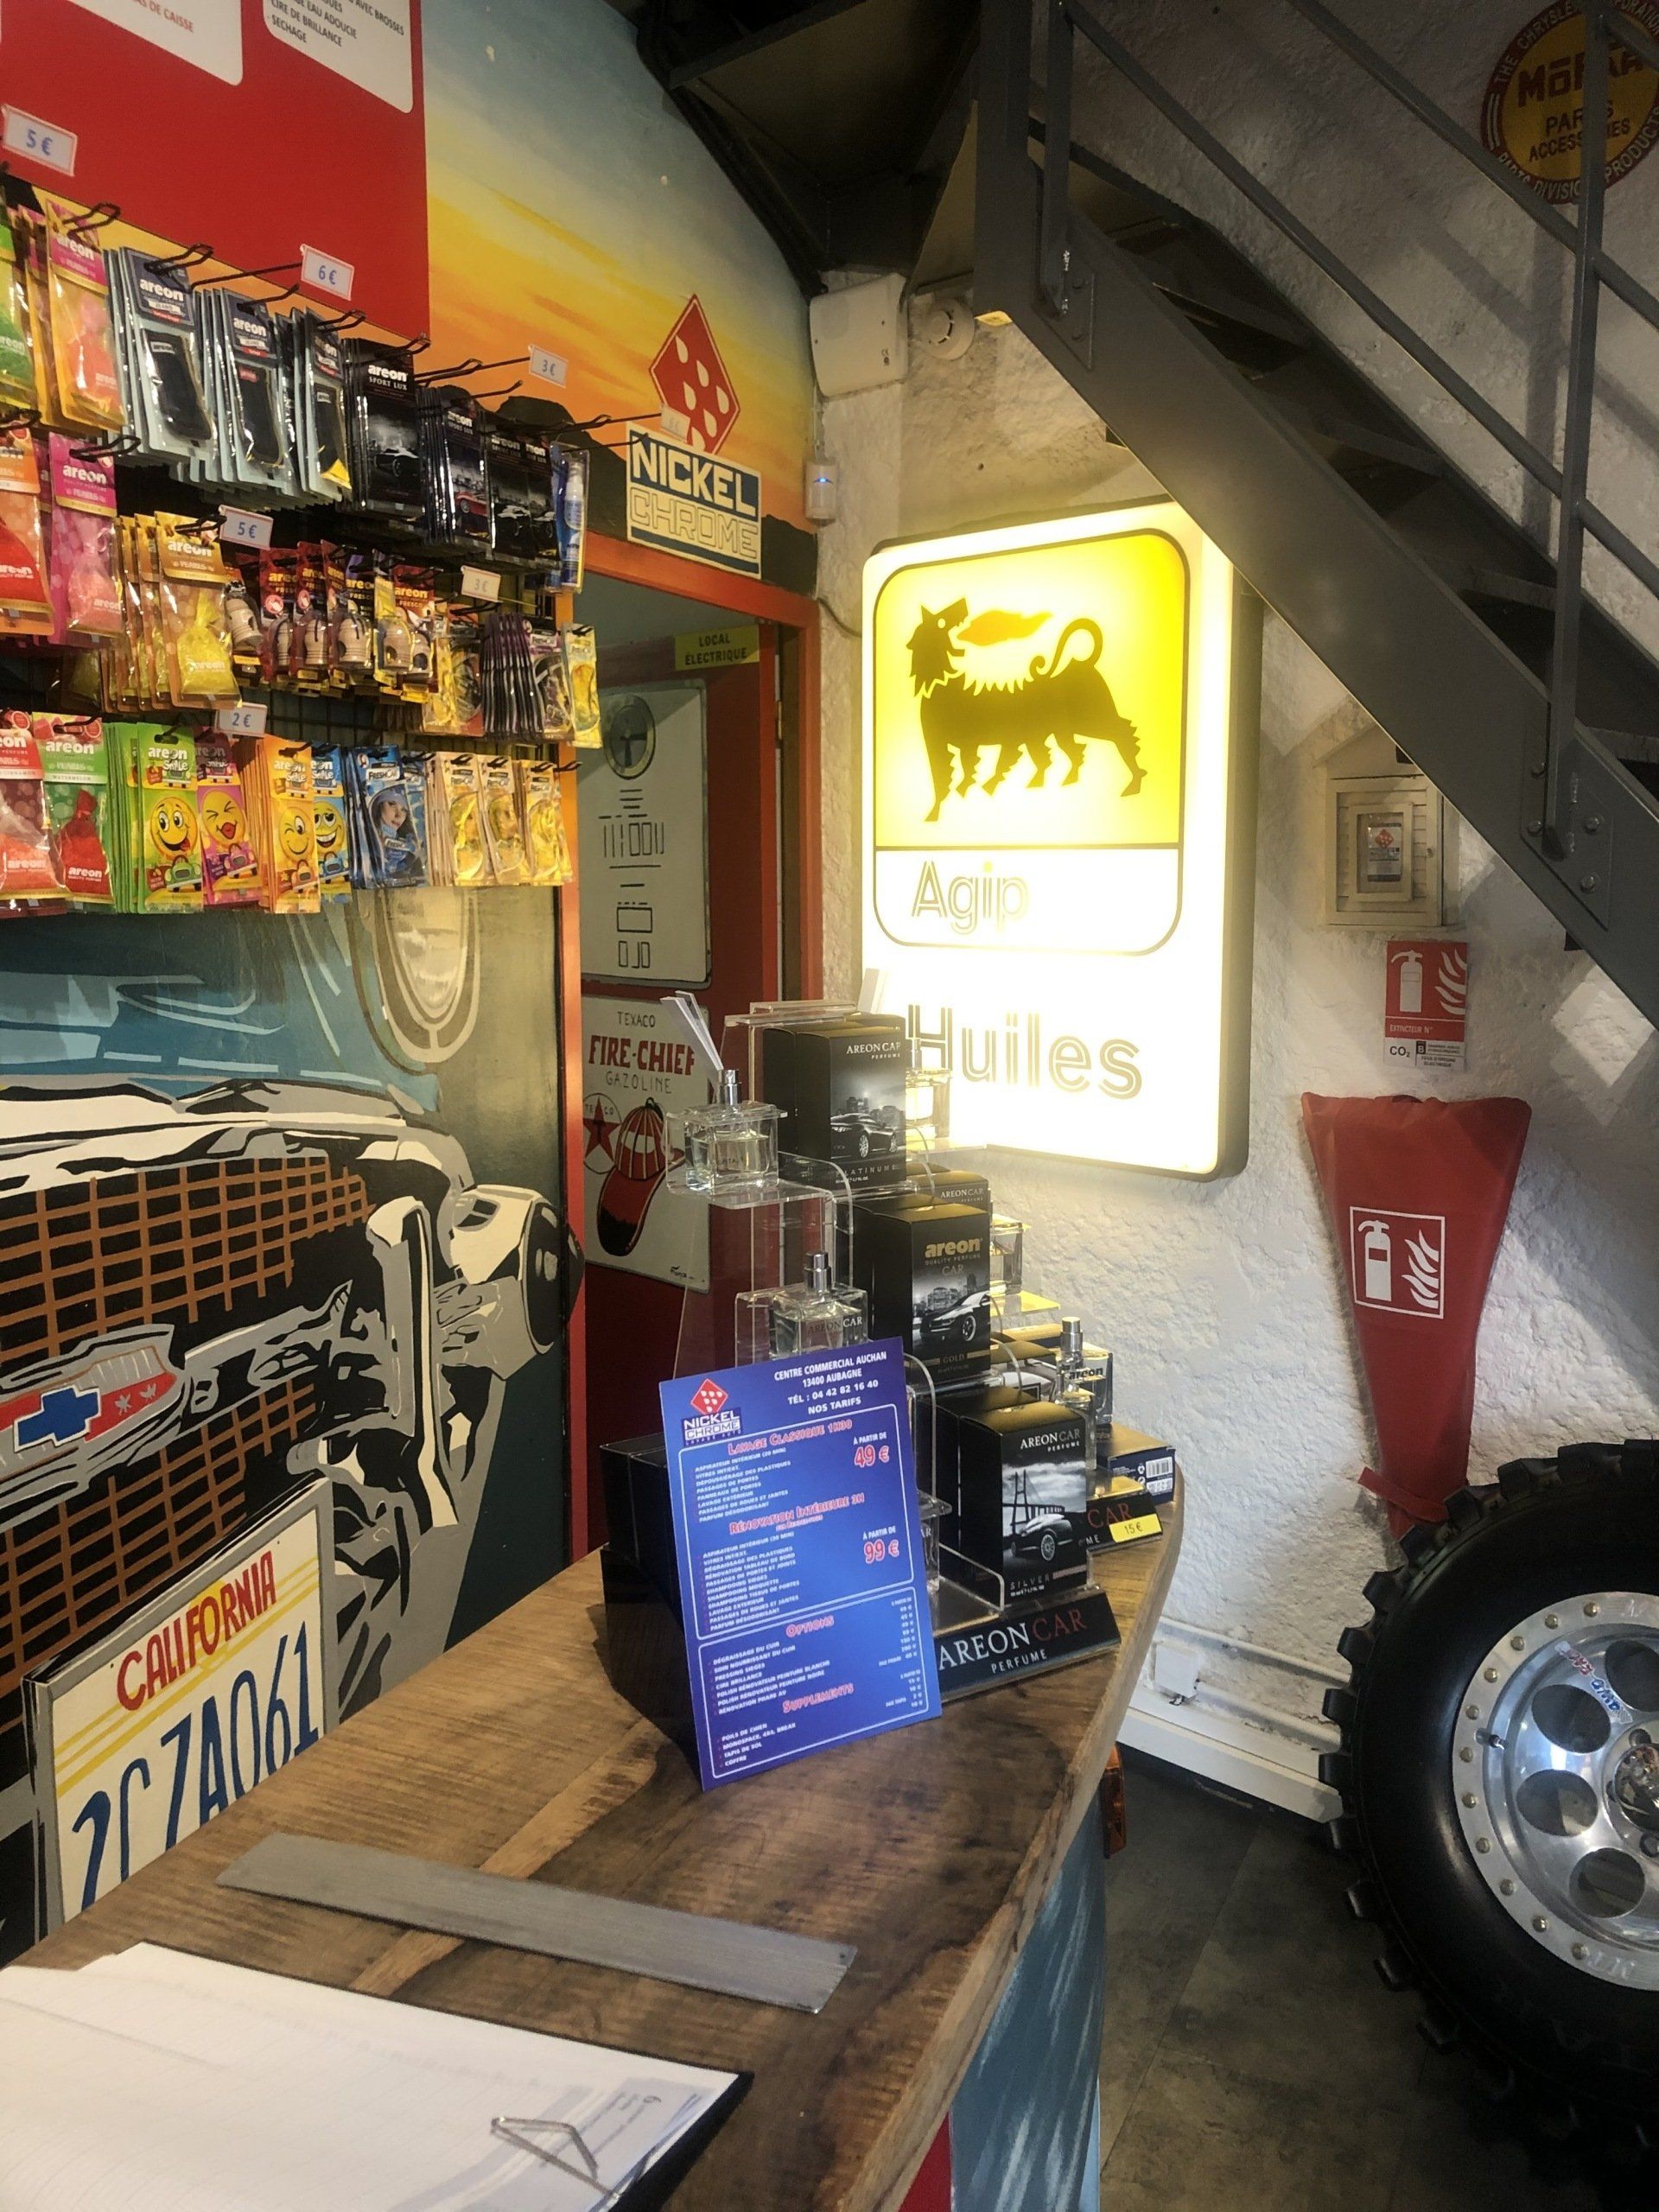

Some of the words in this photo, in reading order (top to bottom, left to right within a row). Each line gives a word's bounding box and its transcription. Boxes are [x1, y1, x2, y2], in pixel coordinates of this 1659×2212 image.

[164, 8, 194, 33] CAISSE
[271, 15, 307, 43] SECHAGE
[290, 8, 301, 22] DE
[302, 16, 342, 47] BRILLANCE
[308, 1, 322, 17] EAU
[324, 11, 358, 39] ADOUCIE
[374, 10, 404, 35] BROSSES
[26, 129, 36, 149] 5
[57, 235, 94, 261] areon
[139, 279, 184, 302] areon
[233, 317, 267, 337] areon
[368, 364, 408, 383] areon
[393, 378, 408, 391] LUX
[63, 465, 106, 484] areon
[632, 435, 757, 517] NICKEL
[238, 522, 245, 535] 5
[631, 486, 758, 557] CHROME
[168, 540, 212, 557] areon
[395, 587, 428, 599] areon
[698, 633, 731, 647] LOCAL
[684, 647, 747, 665] ÉLECTRIQUE
[232, 713, 239, 726] 2
[46, 741, 94, 754] areon
[149, 747, 188, 760] areon
[68, 867, 102, 878] areon
[911, 861, 1028, 936] Agip
[617, 1011, 656, 1027] TEXACO
[1389, 1024, 1422, 1033] EXTINCTEUR
[847, 1043, 880, 1054] AREON
[907, 1004, 1143, 1100] Huiles
[606, 1071, 672, 1094] GAZOLINE
[940, 1189, 967, 1199] AREON
[968, 1187, 984, 1197] CAR
[925, 1238, 981, 1258] areon
[942, 1264, 964, 1276] CAR
[843, 1315, 863, 1328] CAR
[773, 1367, 802, 1381] CENTRE
[804, 1357, 855, 1375] COMMERCIAL
[855, 1351, 887, 1365] AUCHAN
[943, 1353, 965, 1363] GOLD
[802, 1376, 824, 1388] 13400
[825, 1368, 861, 1383] AUBAGNE
[1069, 1367, 1104, 1381] areon
[787, 1393, 804, 1405] TÉL
[811, 1390, 823, 1400] 04
[825, 1388, 837, 1397] 42
[839, 1385, 851, 1395] 82
[854, 1382, 864, 1391] 16
[867, 1379, 878, 1389] 40
[808, 1403, 828, 1414] NOS
[830, 1396, 861, 1410] TARIFS
[683, 1408, 740, 1430] NICKEL
[686, 1420, 739, 1439] CHROME
[858, 1433, 878, 1443] PARTIR
[1020, 1432, 1058, 1450] AREON
[1058, 1428, 1081, 1441] CAR
[853, 1443, 876, 1469] 49
[877, 1444, 890, 1464] €
[1087, 1503, 1133, 1529] CAR
[868, 1527, 887, 1538] PARTIR
[863, 1537, 886, 1565] 99
[887, 1538, 899, 1559] €
[1010, 1575, 1052, 1590] SILVER
[116, 1551, 276, 1710] CALIFORNIA
[939, 1622, 1031, 1671] AREON
[1032, 1608, 1088, 1641] CAR
[991, 1649, 1048, 1673] PERFUME
